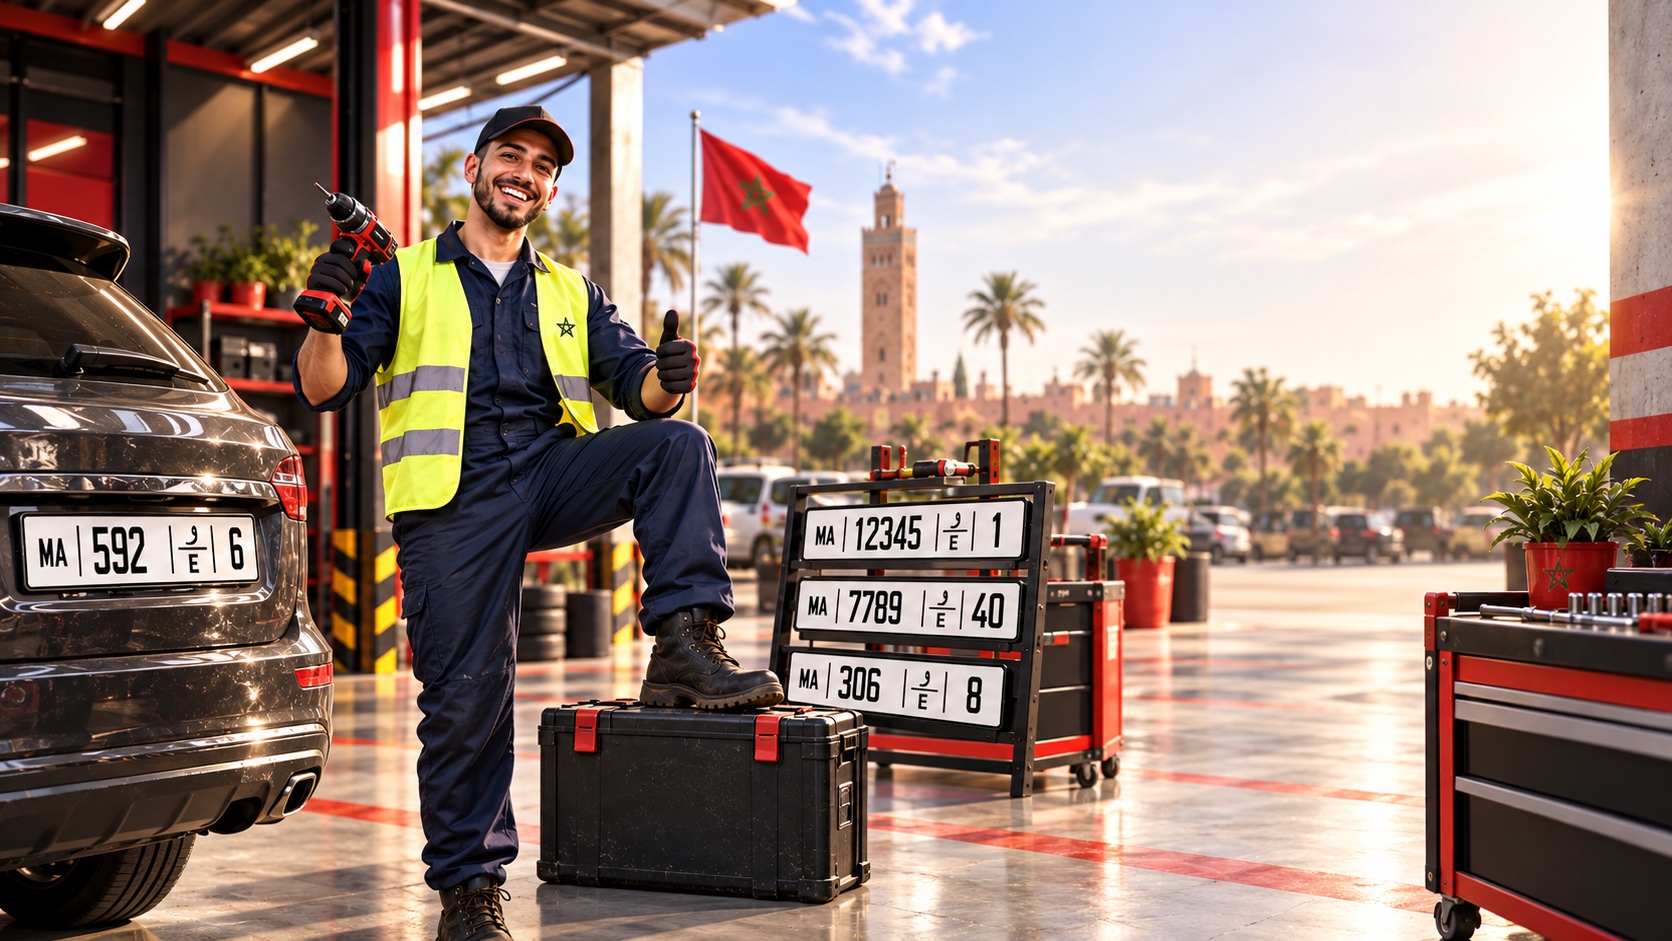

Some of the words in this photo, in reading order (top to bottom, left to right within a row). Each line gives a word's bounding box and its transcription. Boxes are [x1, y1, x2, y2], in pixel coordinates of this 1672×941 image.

[38, 537, 69, 568] MA
[91, 526, 148, 575] 592
[188, 553, 200, 574] E
[228, 526, 245, 571] 6
[814, 525, 835, 546] MA
[855, 514, 923, 551] 12345
[948, 534, 959, 551] E
[992, 511, 1002, 549] 1
[807, 595, 828, 617] MA
[848, 589, 903, 625] 7789
[935, 612, 946, 629] E
[971, 592, 1005, 629] 40
[798, 667, 819, 691] MA
[837, 665, 882, 703] 306
[917, 693, 929, 711] E
[965, 675, 983, 715] 8
